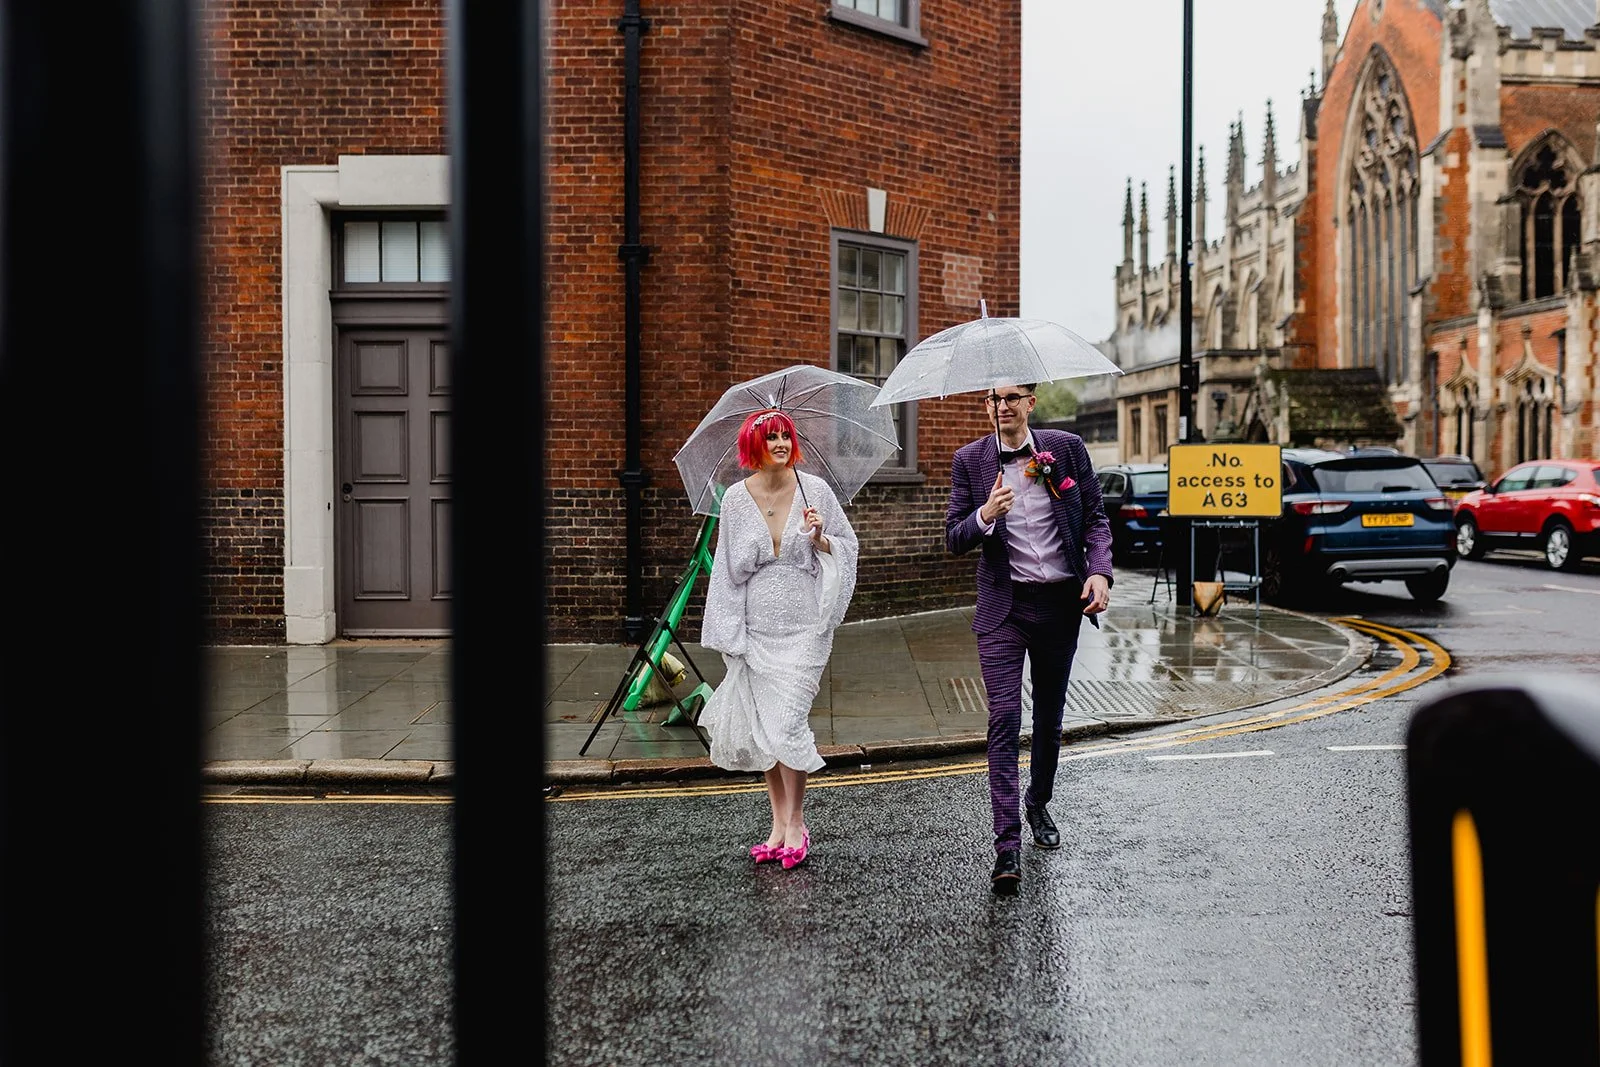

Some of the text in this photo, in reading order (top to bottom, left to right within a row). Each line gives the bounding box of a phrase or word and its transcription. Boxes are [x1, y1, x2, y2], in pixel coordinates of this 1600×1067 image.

[1212, 453, 1240, 467] No
[1177, 474, 1275, 488] access to
[1202, 492, 1248, 508] A63
